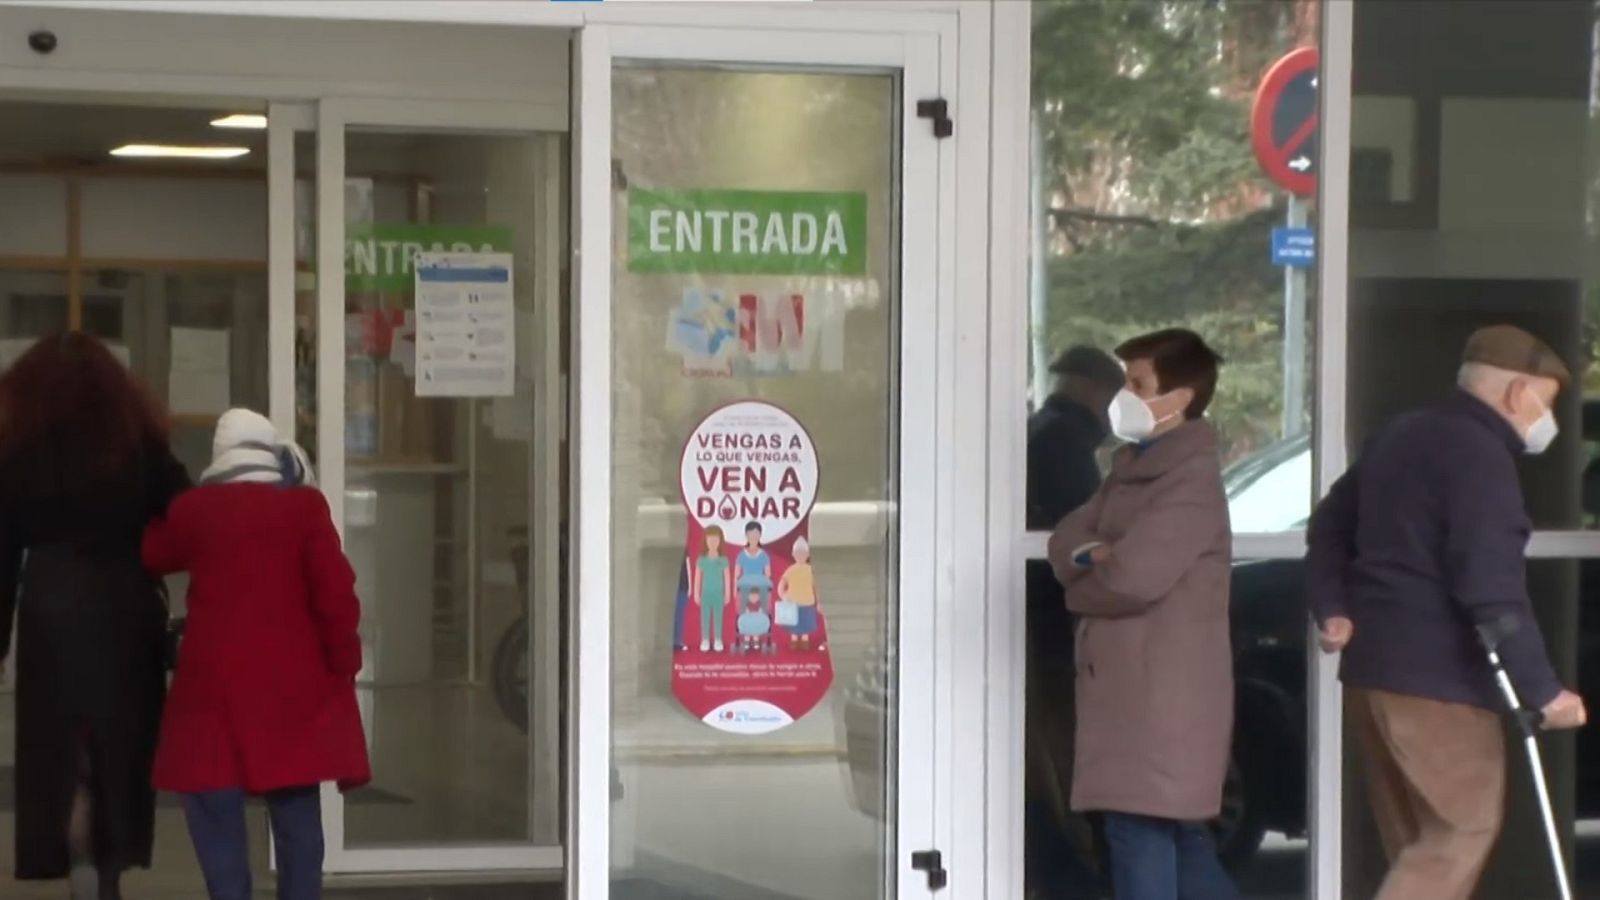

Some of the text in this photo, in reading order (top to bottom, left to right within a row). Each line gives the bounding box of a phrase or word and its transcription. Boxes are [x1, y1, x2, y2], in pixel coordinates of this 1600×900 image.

[649, 209, 847, 255] ENTRADA
[697, 433, 802, 449] VENGAS A
[696, 452, 803, 464] LO QUE VENGAS,
[697, 465, 802, 493] VEN A
[696, 495, 802, 520] DONAR
